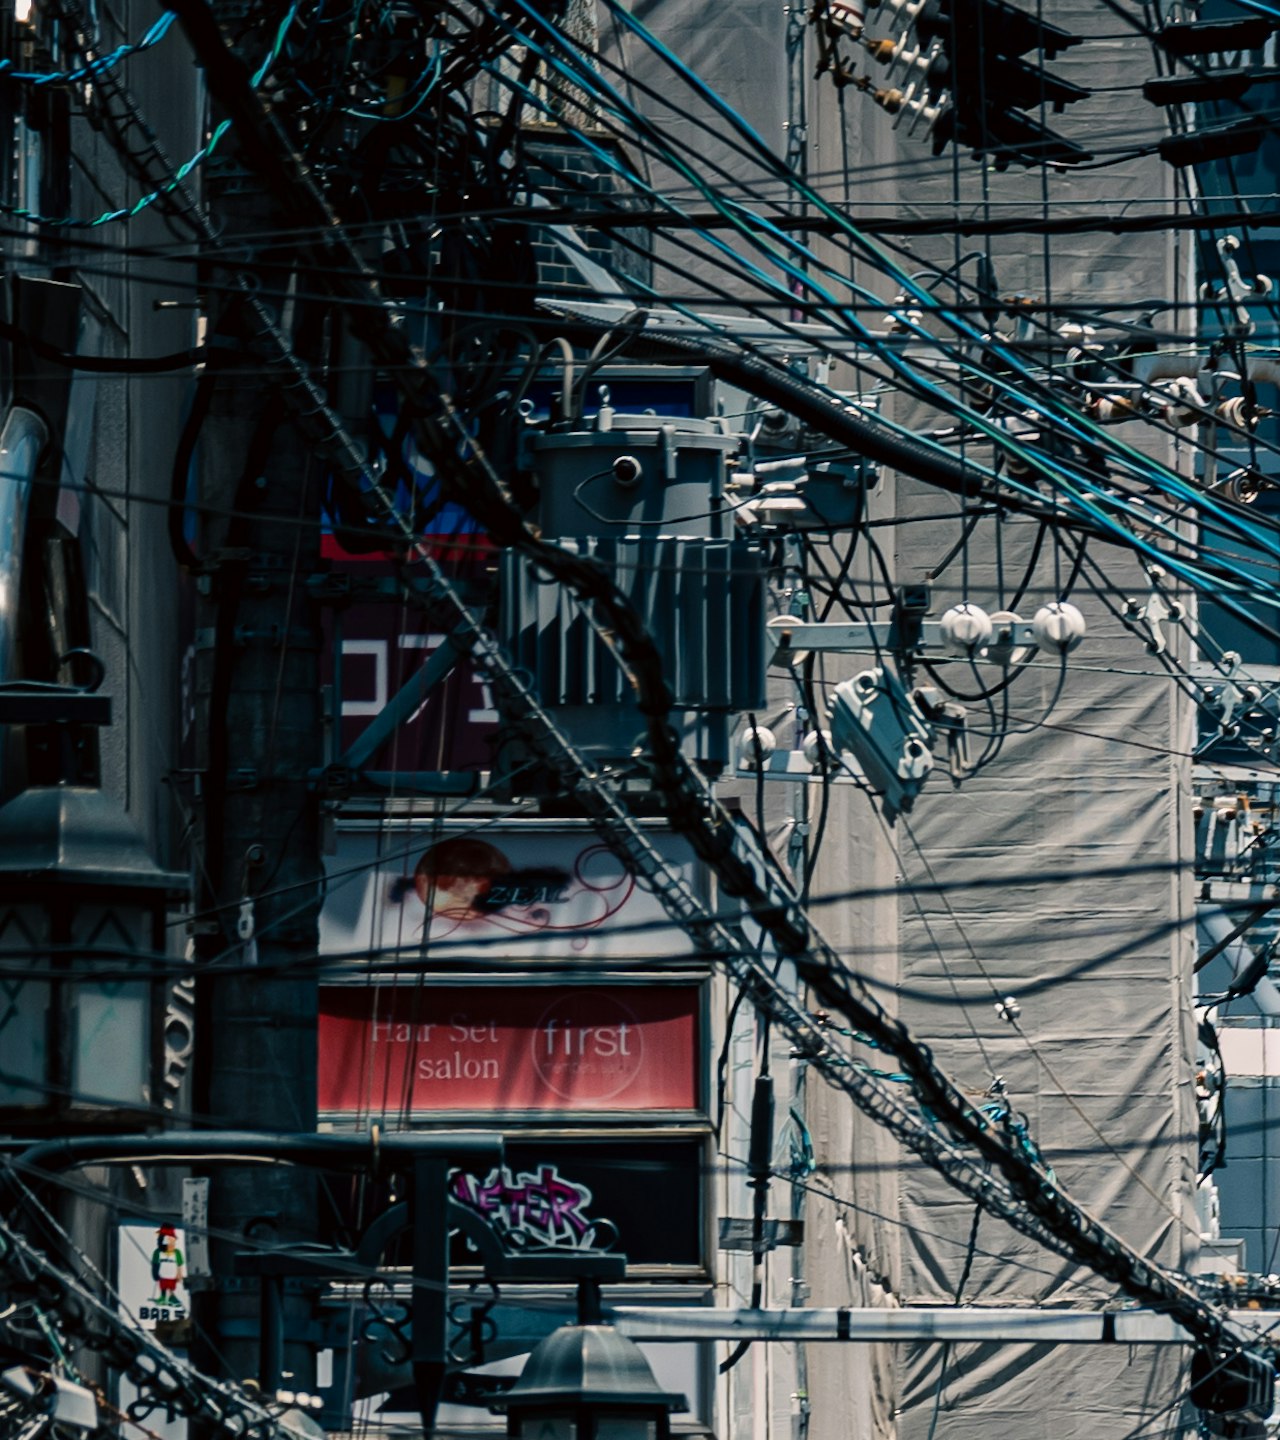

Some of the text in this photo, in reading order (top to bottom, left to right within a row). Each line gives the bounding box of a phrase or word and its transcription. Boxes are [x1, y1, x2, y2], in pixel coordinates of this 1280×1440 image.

[371, 1013, 500, 1043] Hair Set
[543, 1018, 631, 1057] first
[418, 1051, 500, 1080] salon
